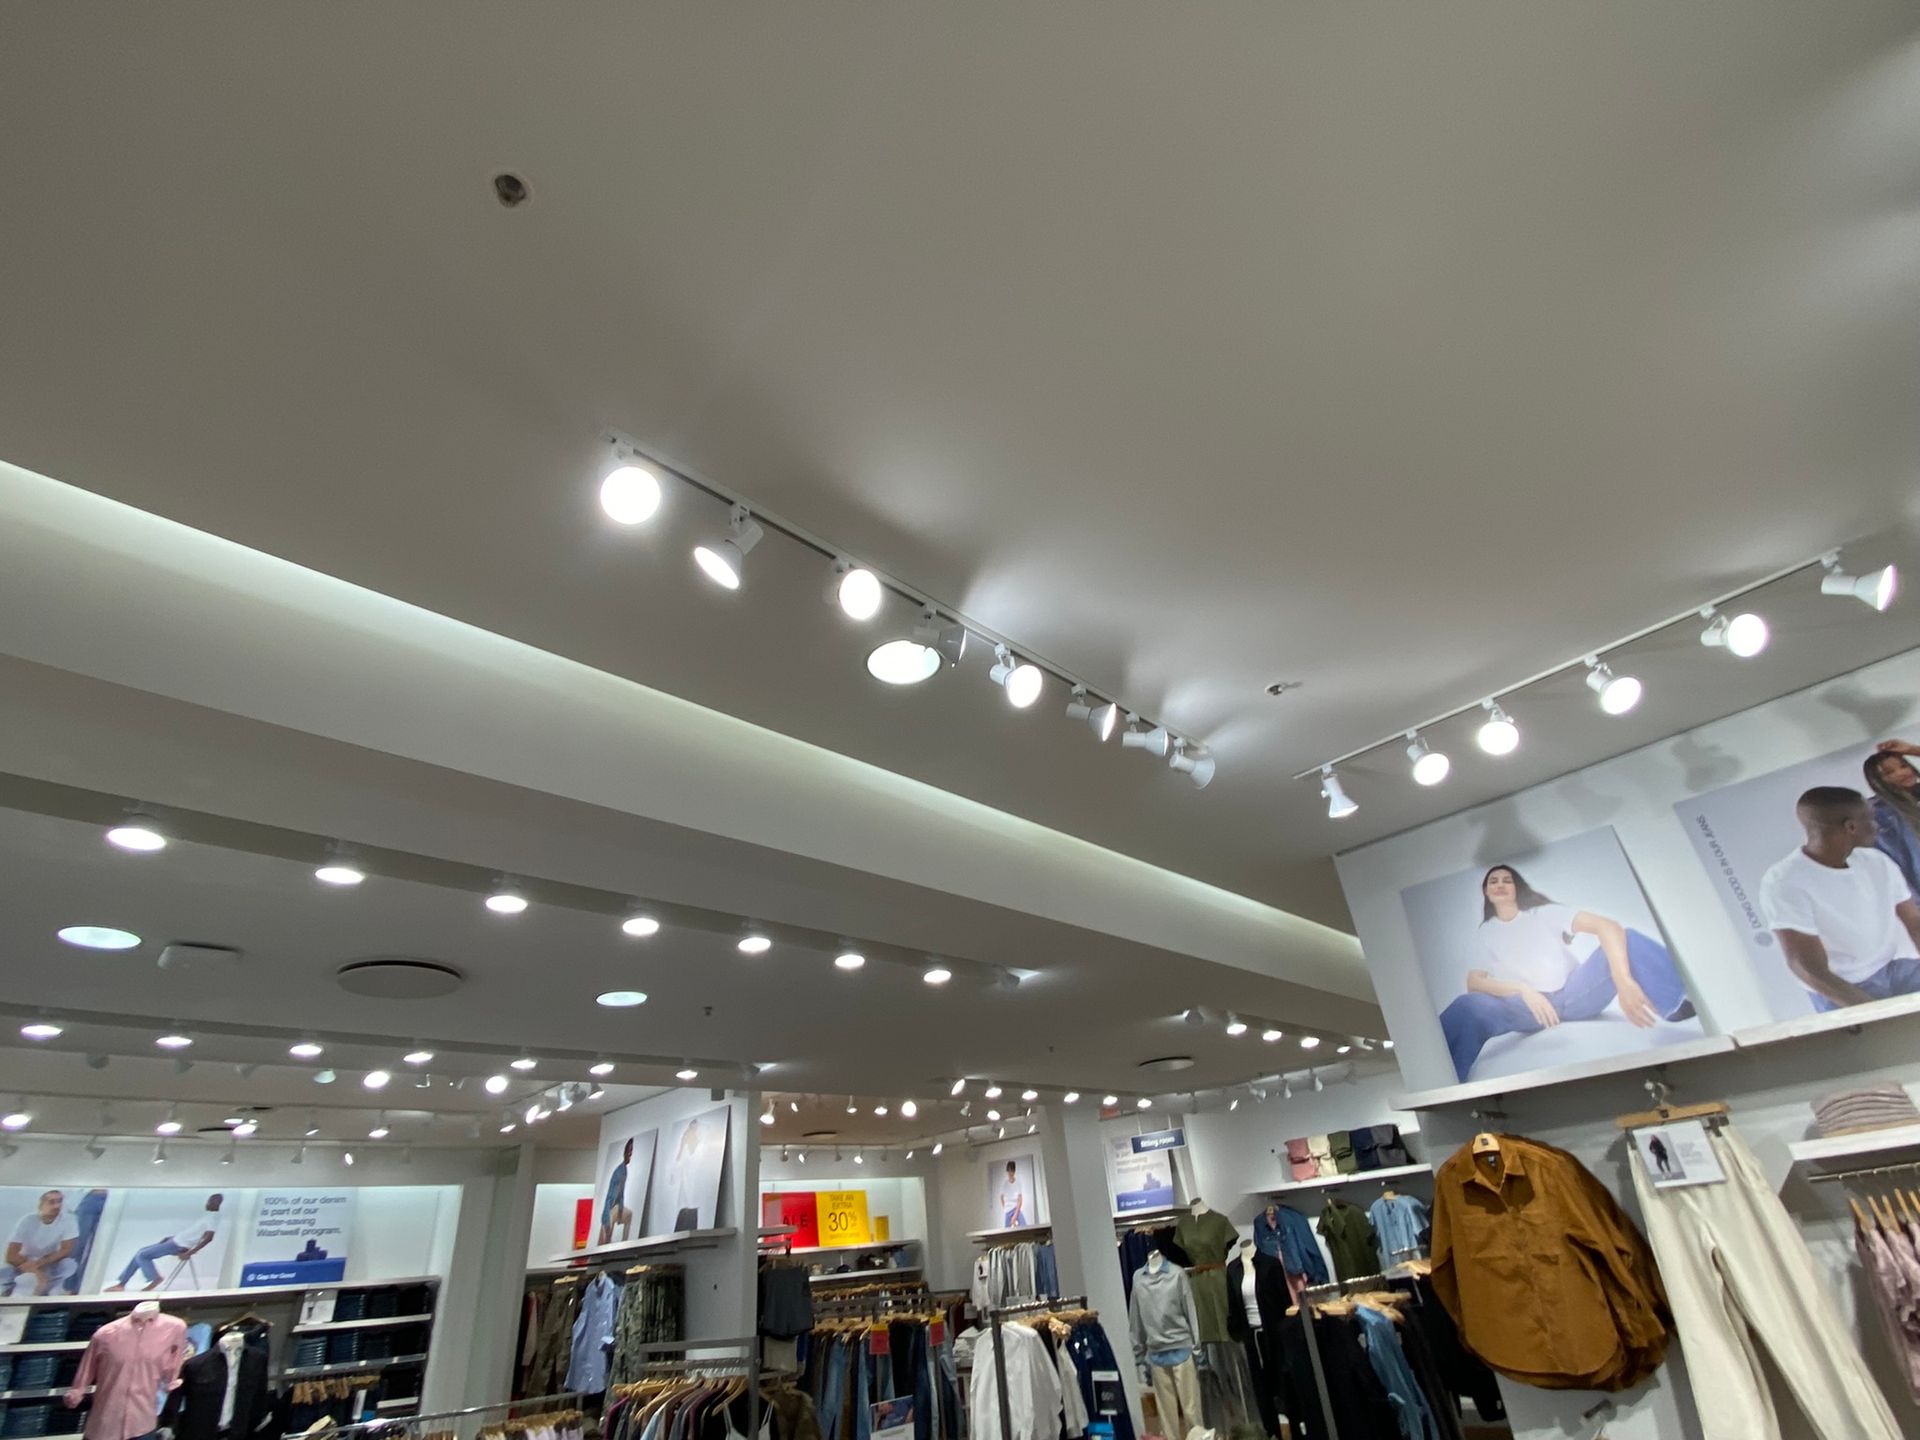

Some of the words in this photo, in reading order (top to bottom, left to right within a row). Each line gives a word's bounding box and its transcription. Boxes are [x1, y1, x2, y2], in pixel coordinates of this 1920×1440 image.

[1709, 840, 1724, 858] OUR
[1728, 876, 1747, 901] GOOD
[1741, 901, 1761, 928] DOING
[291, 1197, 301, 1205] of
[302, 1197, 318, 1205] our
[261, 1208, 269, 1216] is
[270, 1207, 290, 1217] part
[291, 1206, 302, 1215] of
